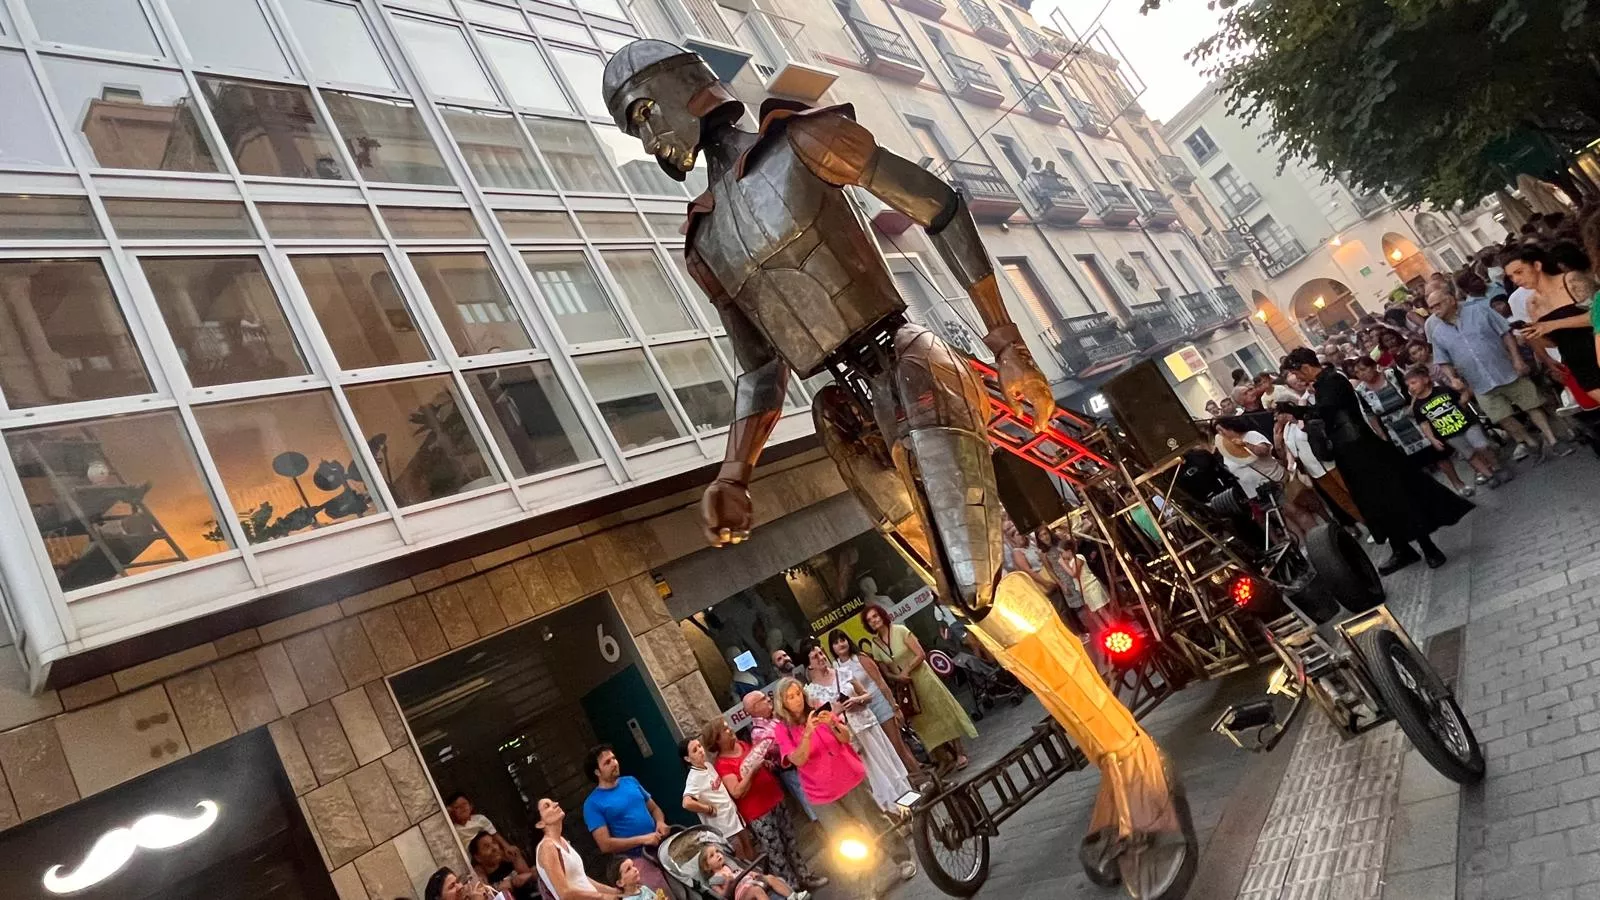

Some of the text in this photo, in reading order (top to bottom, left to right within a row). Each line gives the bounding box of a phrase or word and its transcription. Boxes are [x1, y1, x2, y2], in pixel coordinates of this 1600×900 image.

[1232, 215, 1274, 267] HOSTAL
[811, 596, 864, 632] REMATE FINAL
[596, 624, 621, 663] 6
